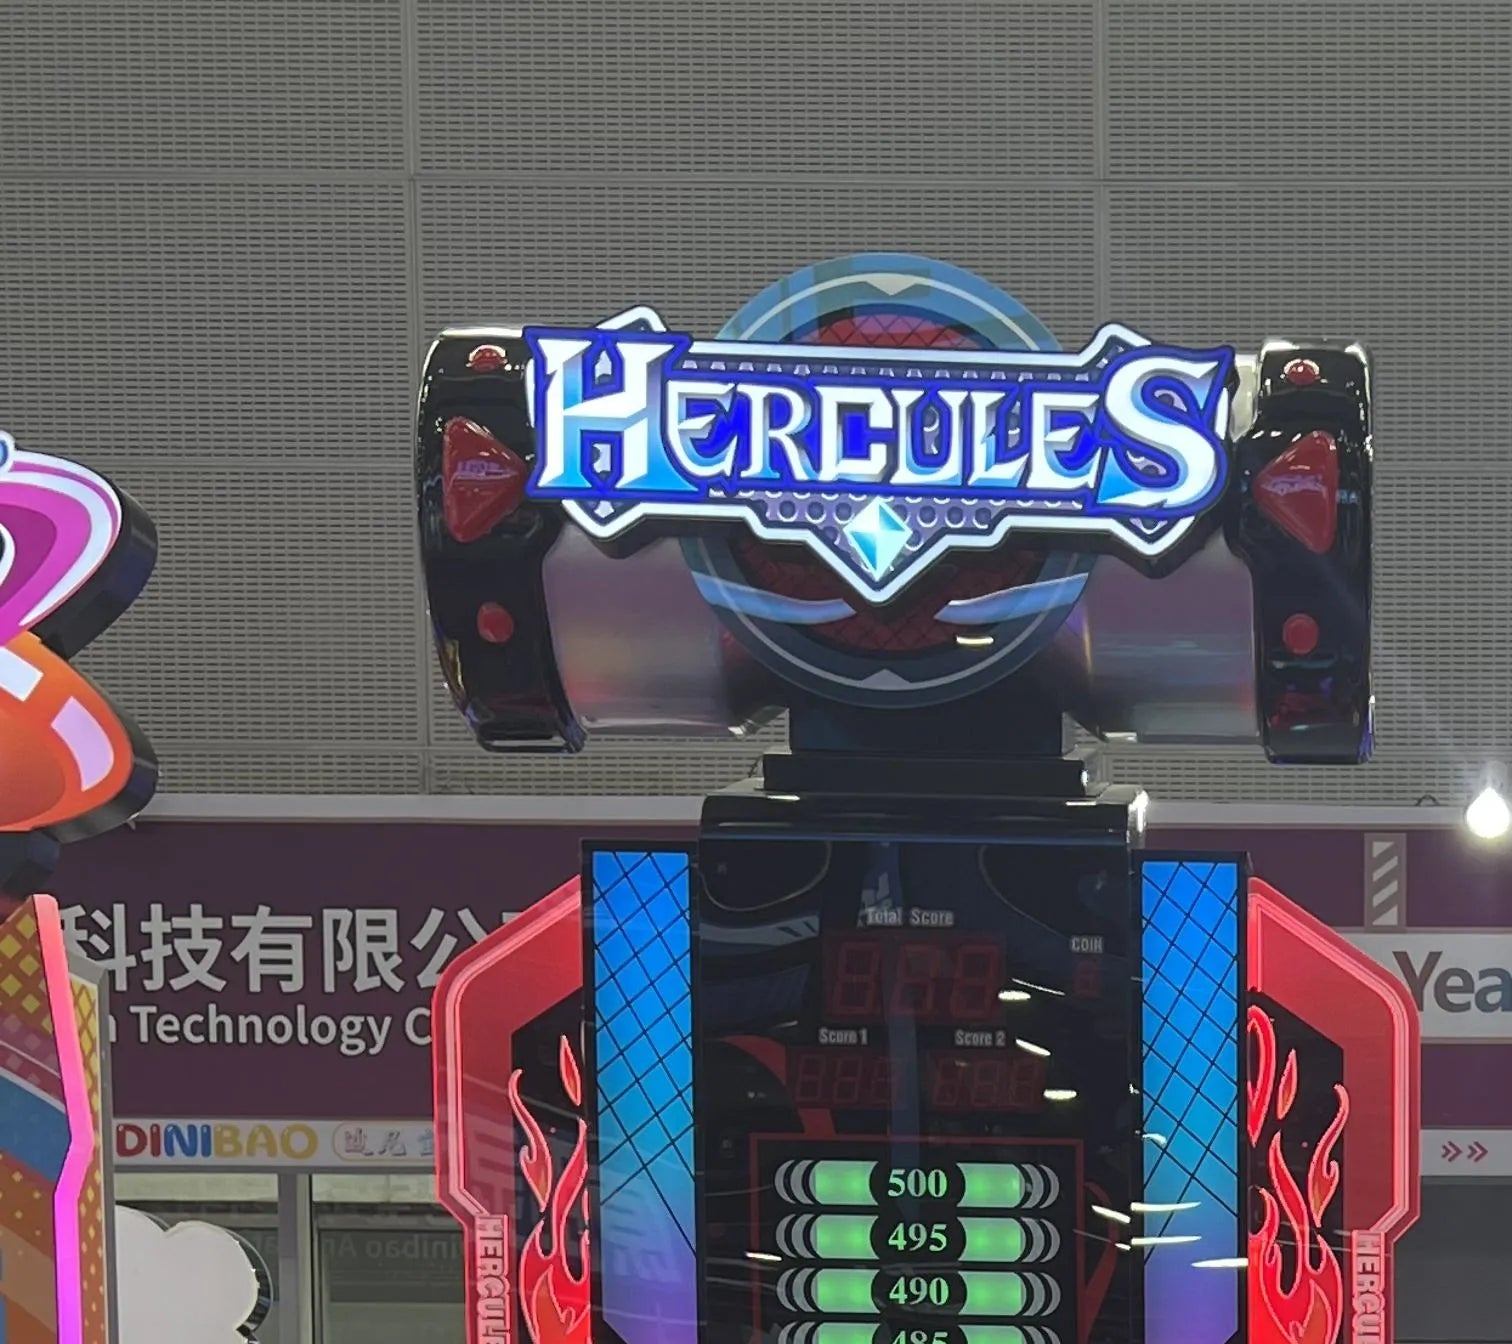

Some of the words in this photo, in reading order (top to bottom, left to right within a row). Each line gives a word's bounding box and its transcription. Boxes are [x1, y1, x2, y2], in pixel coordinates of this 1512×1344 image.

[527, 330, 1231, 513] HERCULES
[866, 907, 901, 926] Total
[910, 909, 954, 926] Score
[59, 904, 521, 993] 科技有限公
[1070, 936, 1103, 953] COIN
[129, 1003, 392, 1055] Technology
[818, 1027, 857, 1046] Score
[859, 1028, 868, 1046] 1
[955, 1028, 993, 1047] Score
[995, 1029, 1006, 1047] 2
[116, 1123, 319, 1160] DINIBAO
[887, 1169, 948, 1198] 500
[888, 1222, 947, 1252] 495
[889, 1276, 949, 1306] 490
